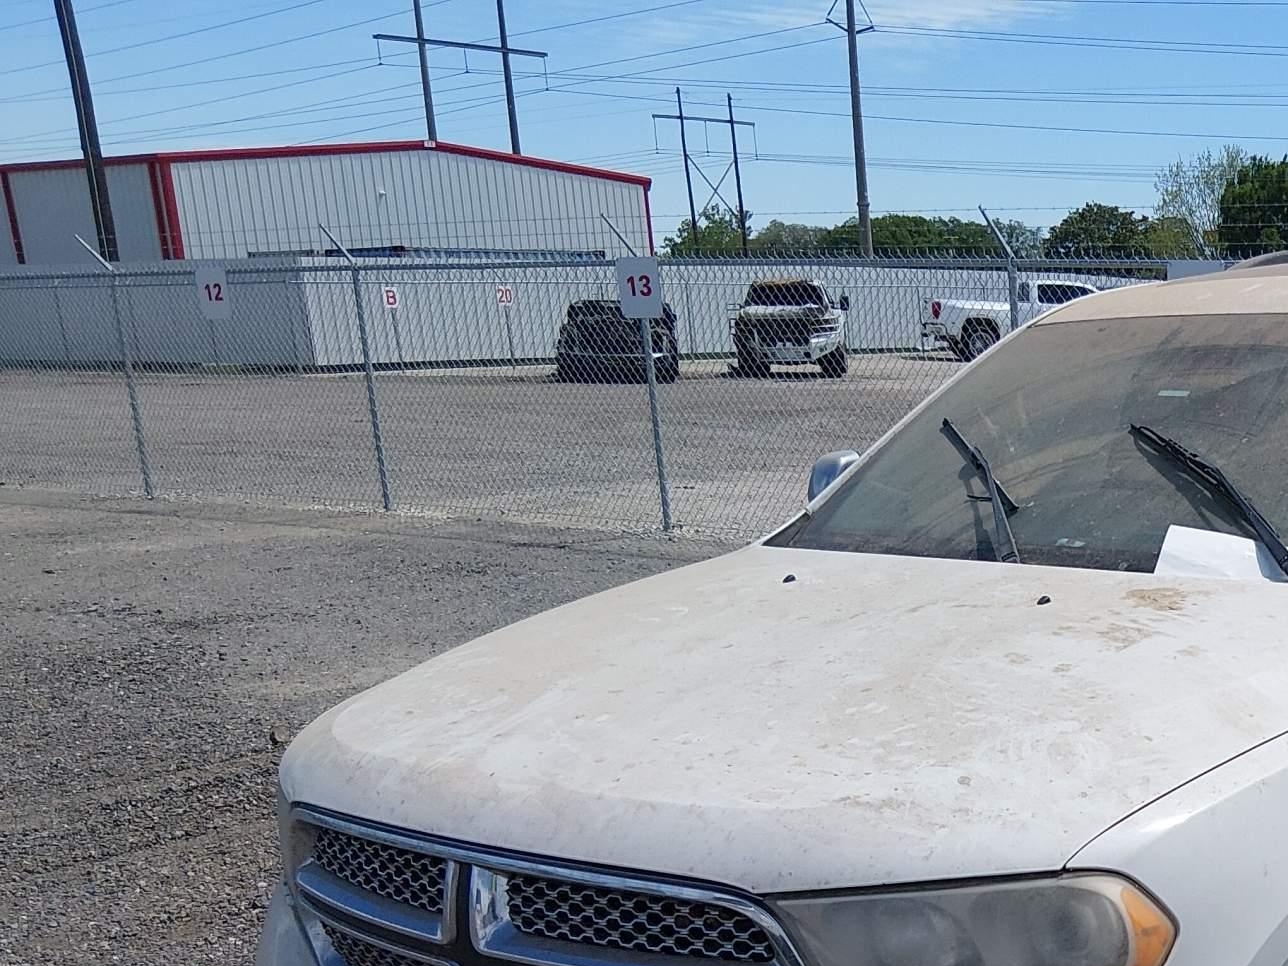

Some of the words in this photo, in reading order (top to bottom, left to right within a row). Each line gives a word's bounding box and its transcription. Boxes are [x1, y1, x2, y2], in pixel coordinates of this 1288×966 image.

[204, 283, 224, 301] 12
[626, 275, 653, 297] 13
[385, 290, 397, 306] B
[497, 288, 513, 304] 20
